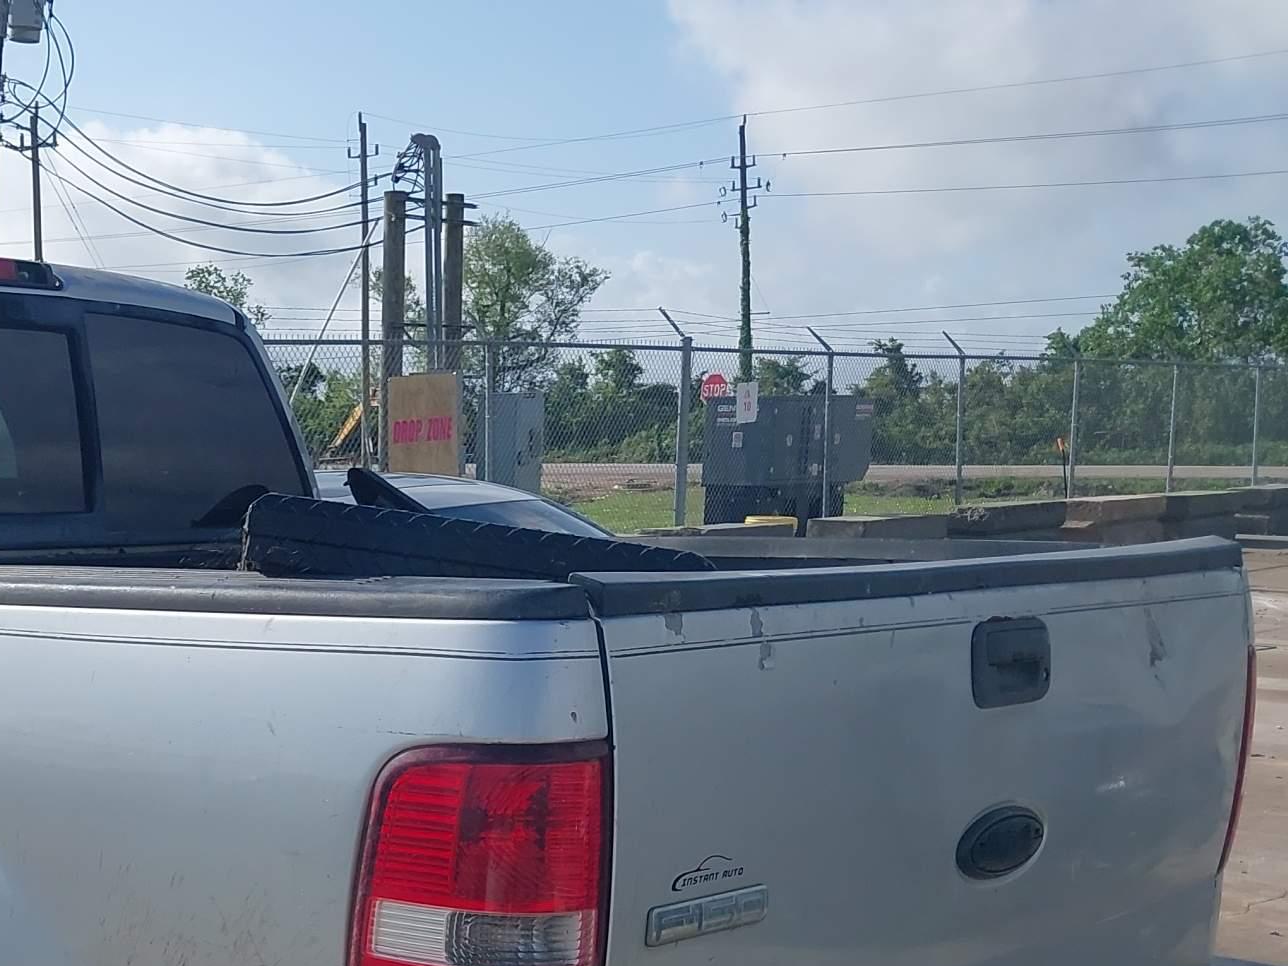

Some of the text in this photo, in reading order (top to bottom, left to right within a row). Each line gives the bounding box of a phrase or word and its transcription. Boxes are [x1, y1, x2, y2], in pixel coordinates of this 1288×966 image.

[703, 384, 727, 397] STOP
[393, 416, 453, 444] DROP ZONE
[681, 867, 744, 887] INSTANT AUTO
